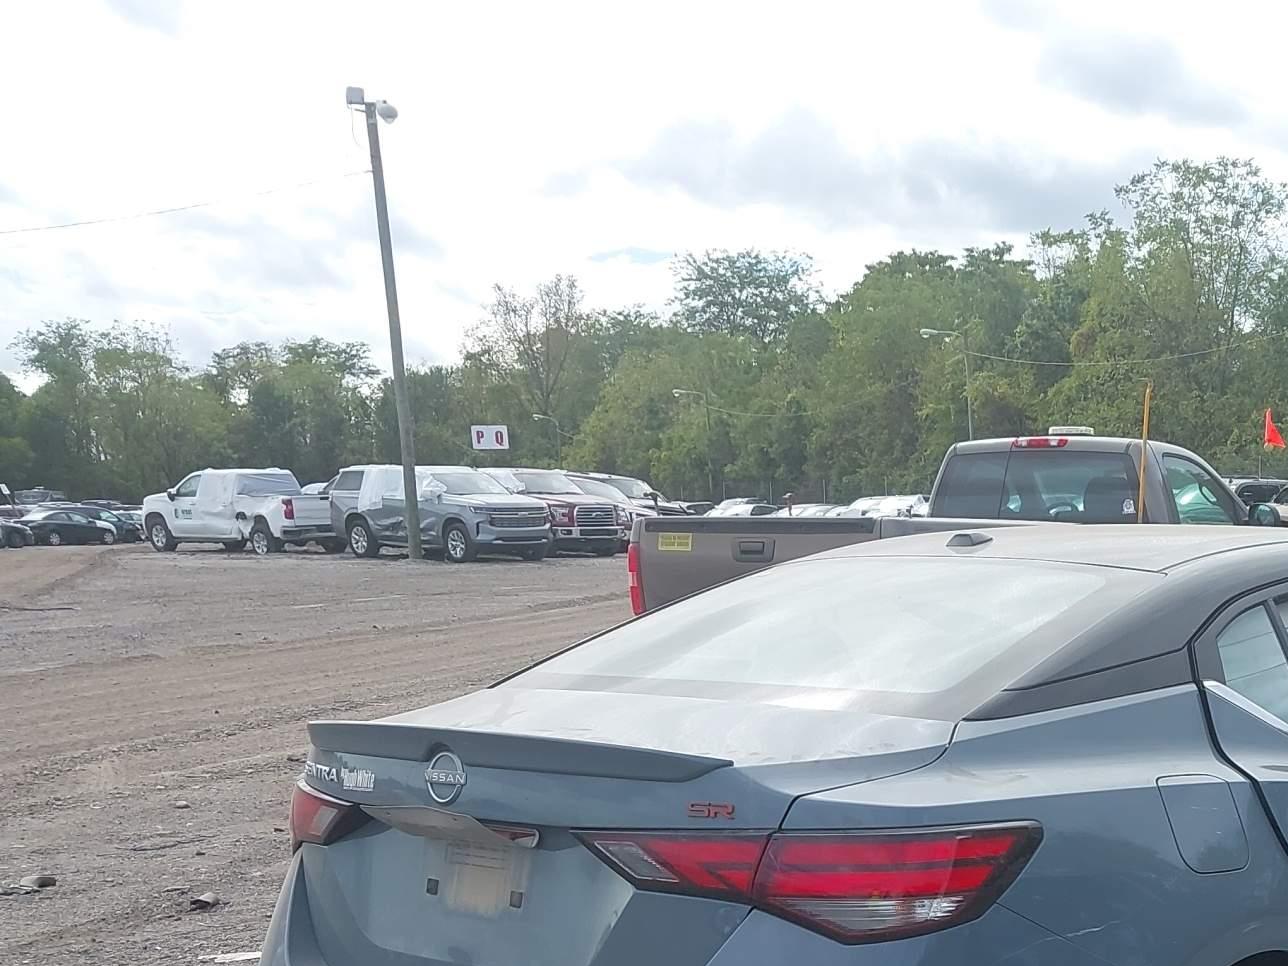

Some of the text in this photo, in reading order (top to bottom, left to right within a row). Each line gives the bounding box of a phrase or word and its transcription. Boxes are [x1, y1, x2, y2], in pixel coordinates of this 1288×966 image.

[476, 430, 504, 446] P Q
[424, 770, 466, 784] NISSAN
[688, 802, 736, 820] SR
